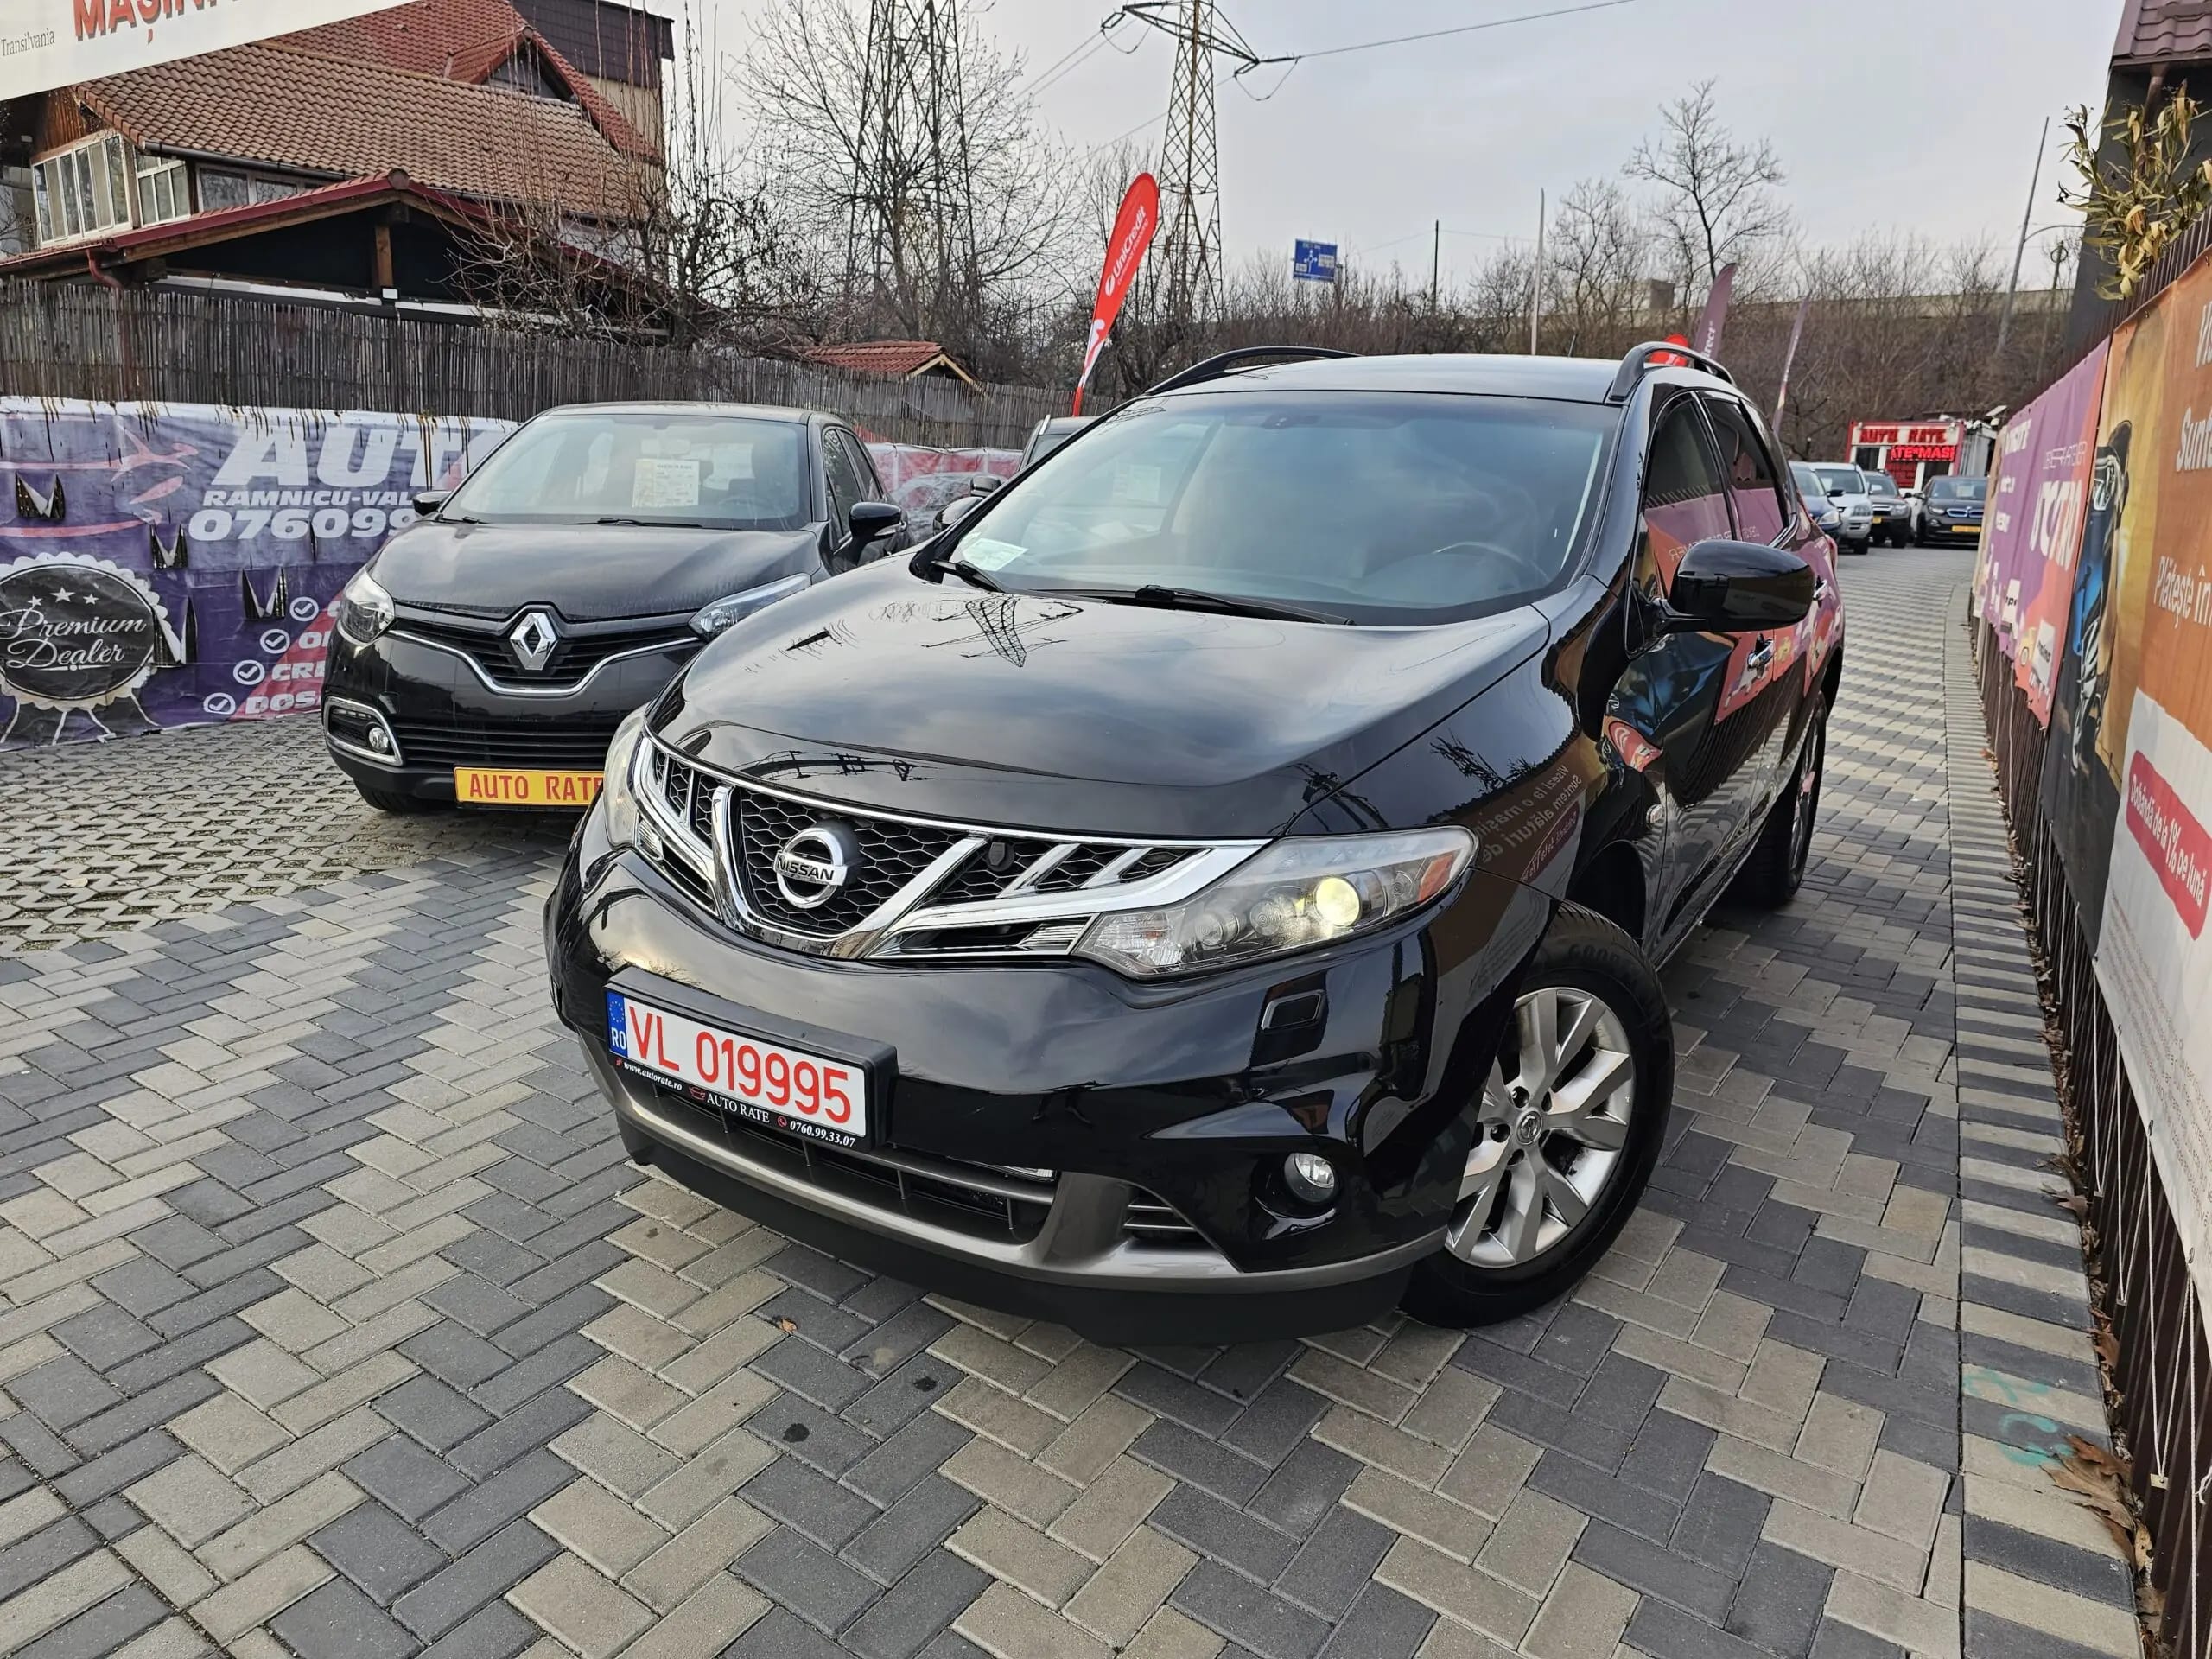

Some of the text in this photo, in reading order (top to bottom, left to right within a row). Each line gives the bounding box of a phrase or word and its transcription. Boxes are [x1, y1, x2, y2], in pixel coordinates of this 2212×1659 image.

[1, 28, 55, 57] Transilvania
[1113, 204, 1146, 277] UniCredit
[1859, 428, 1947, 443] AUTO RATE
[2176, 406, 2212, 472] Sunt
[0, 607, 147, 639] Premium
[6, 638, 125, 669] Dealer
[245, 691, 321, 715] DOS
[469, 773, 529, 799] AUTO
[778, 856, 835, 881] NISSAN
[2152, 806, 2163, 842] de
[2160, 815, 2168, 852] la
[2165, 818, 2182, 874] 1%
[2176, 848, 2189, 881] pe
[2186, 852, 2208, 908] lună
[611, 1027, 627, 1051] RO
[623, 1060, 683, 1091] www.autorate.ro
[628, 1005, 851, 1124] VL 019995
[706, 1093, 771, 1123] AUTO RATE
[789, 1120, 856, 1148] 0760.99.33.07
